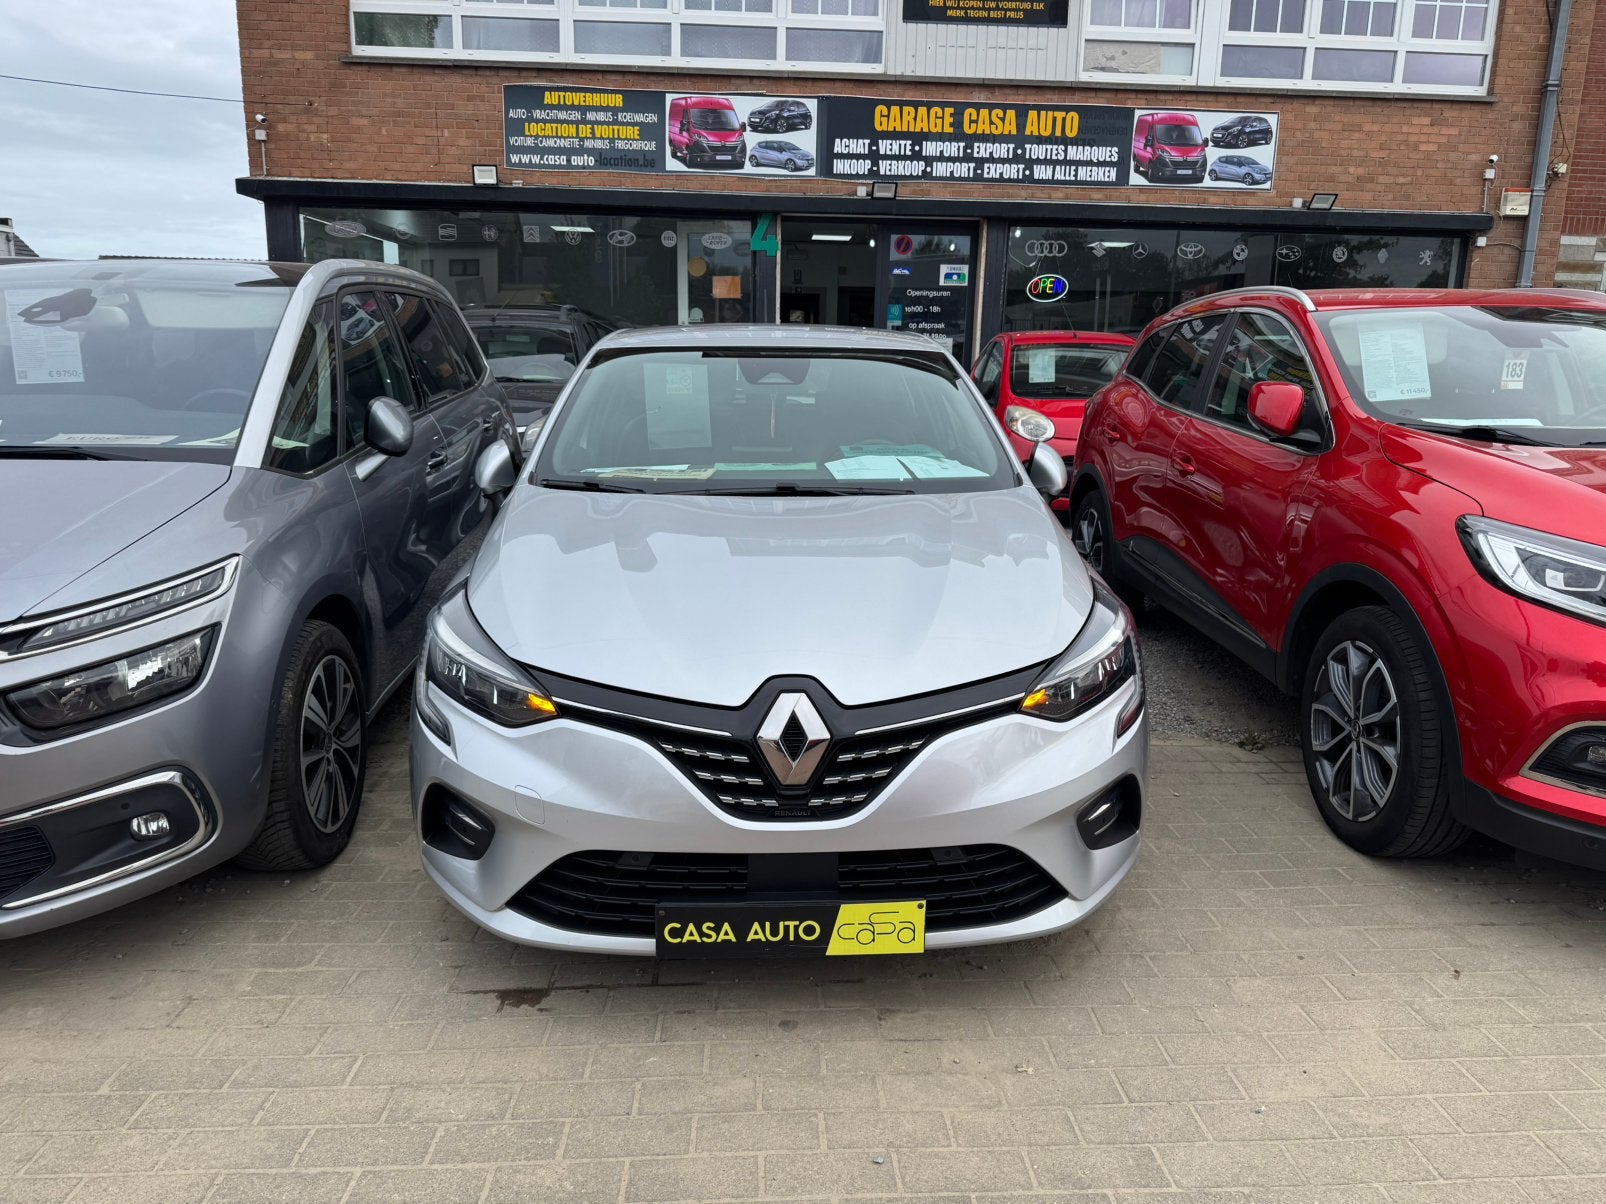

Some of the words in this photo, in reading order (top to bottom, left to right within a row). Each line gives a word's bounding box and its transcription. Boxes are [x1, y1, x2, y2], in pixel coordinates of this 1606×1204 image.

[960, 0, 983, 8] KOPEN
[998, 1, 1031, 9] VOERTUIG
[946, 9, 965, 17] MERK
[1006, 11, 1024, 19] PRIJS
[544, 91, 623, 107] AUTOVERHUUR
[508, 108, 527, 119] AUTO
[532, 109, 581, 120] VRACHTWAGEN
[586, 111, 613, 121] MINIBUS
[618, 112, 658, 123] KOELWAGEN
[874, 105, 954, 133] GARAGE
[963, 108, 1017, 135] CASA
[1025, 110, 1079, 138] AUTO
[525, 122, 576, 137] LOCATION
[579, 124, 592, 137] DE
[594, 125, 640, 139] VOITURE
[584, 138, 610, 149] MINIBUS
[615, 140, 657, 151] FRIGORIFIQUE
[833, 138, 870, 154] ACHAT
[878, 139, 912, 155] VENTE
[922, 141, 965, 157] IMPORT
[973, 142, 1015, 158] EXPORT
[1025, 144, 1065, 160] TOUTES
[1067, 145, 1118, 163] MARQUES
[833, 158, 871, 174] INKOOP
[879, 160, 925, 176] VERKOOP
[932, 162, 975, 178] IMPORT
[983, 163, 1025, 179] EXPORT
[1033, 165, 1053, 180] VAN
[1054, 165, 1075, 180] ALLE
[1077, 166, 1117, 182] MERKEN
[751, 213, 779, 257] 4
[906, 289, 951, 298] Openingsuren
[1031, 278, 1065, 294] OPEN
[929, 305, 941, 313] 18h
[918, 321, 945, 329] afspraak
[1505, 362, 1524, 378] 183
[774, 809, 811, 817] RENAULT
[663, 922, 737, 943] CASA
[746, 920, 821, 943] AUTO
